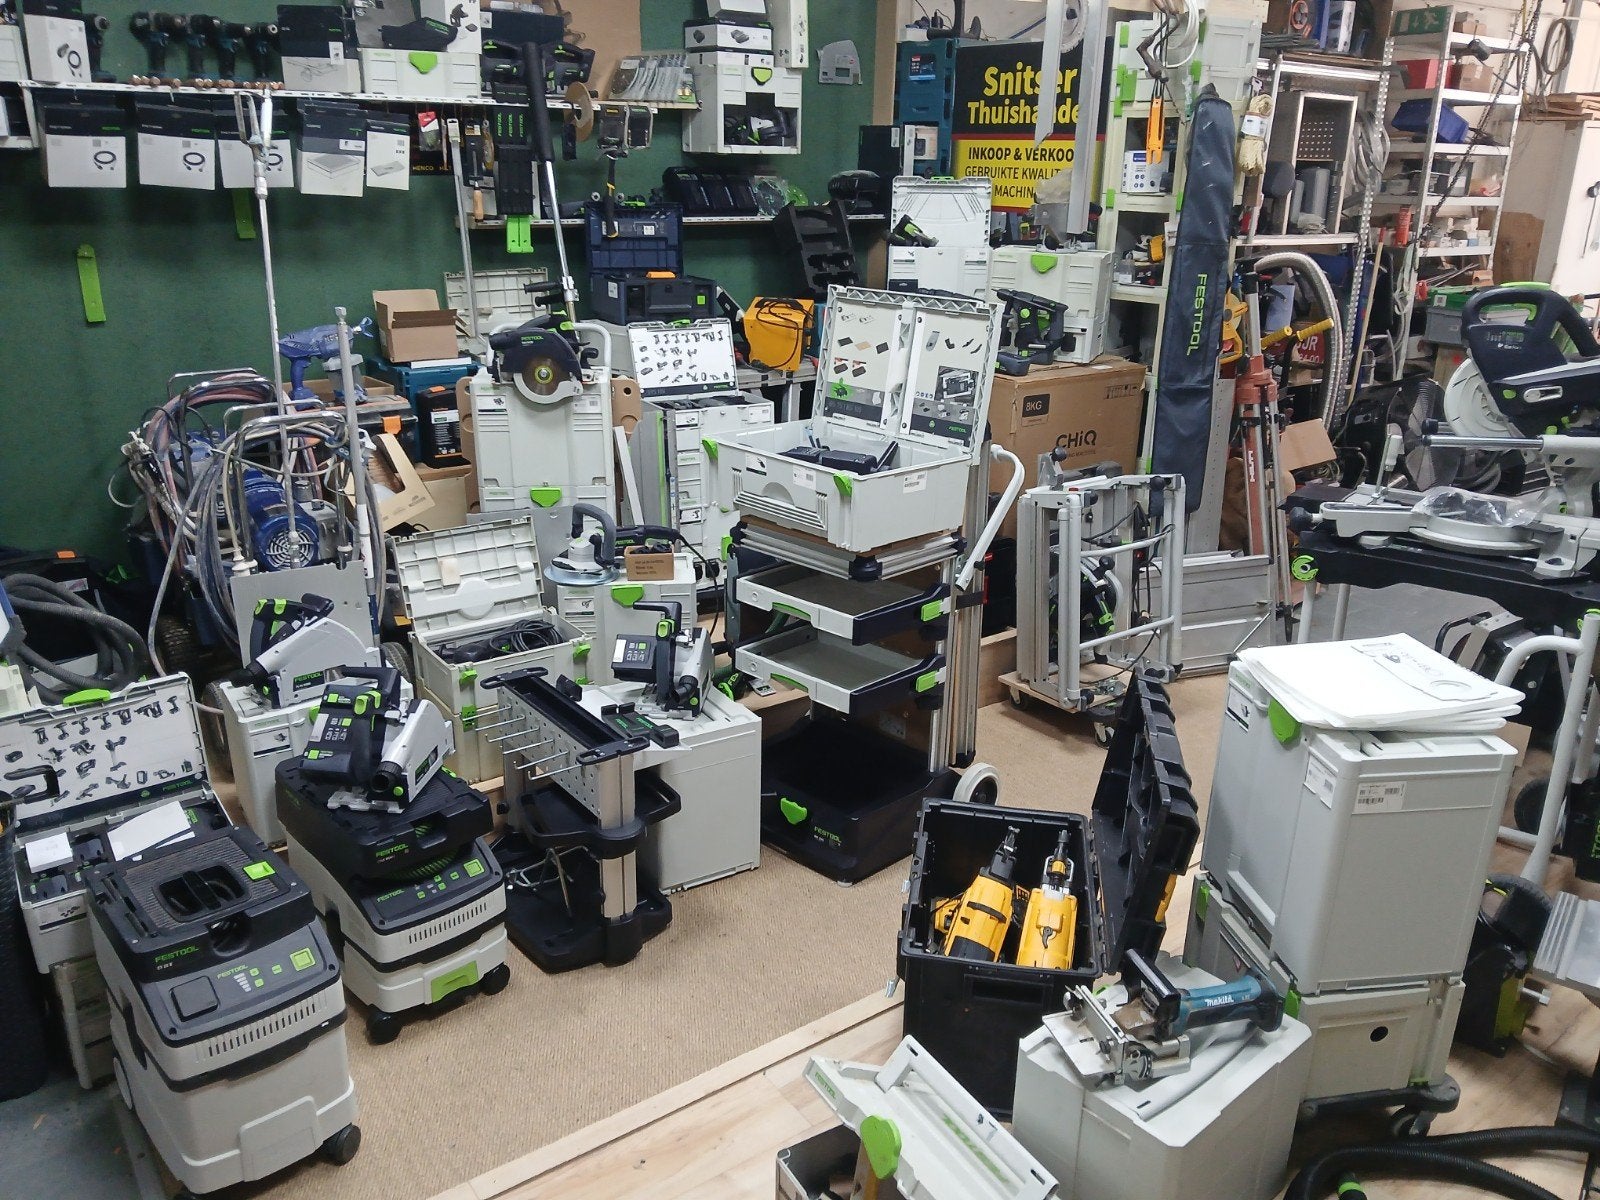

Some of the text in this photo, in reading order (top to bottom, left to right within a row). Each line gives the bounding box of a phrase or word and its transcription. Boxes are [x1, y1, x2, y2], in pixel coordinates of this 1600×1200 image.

[968, 147, 1075, 162] INKOOP & VERKOO
[965, 165, 1019, 180] GEBRUIKTE
[994, 184, 1035, 199] MACHIN
[1186, 273, 1208, 356] FESTOOL
[1025, 400, 1042, 412] 8KG
[1248, 450, 1256, 482] HILTI
[295, 671, 324, 683] FESTOOL
[814, 825, 842, 844] FESTOOL
[375, 843, 409, 858] FESTOOL
[376, 888, 405, 903] FESTOOL
[154, 945, 199, 963] FESTOOL
[217, 964, 249, 979] FESTOOL
[814, 1071, 837, 1100] FESTOOL
